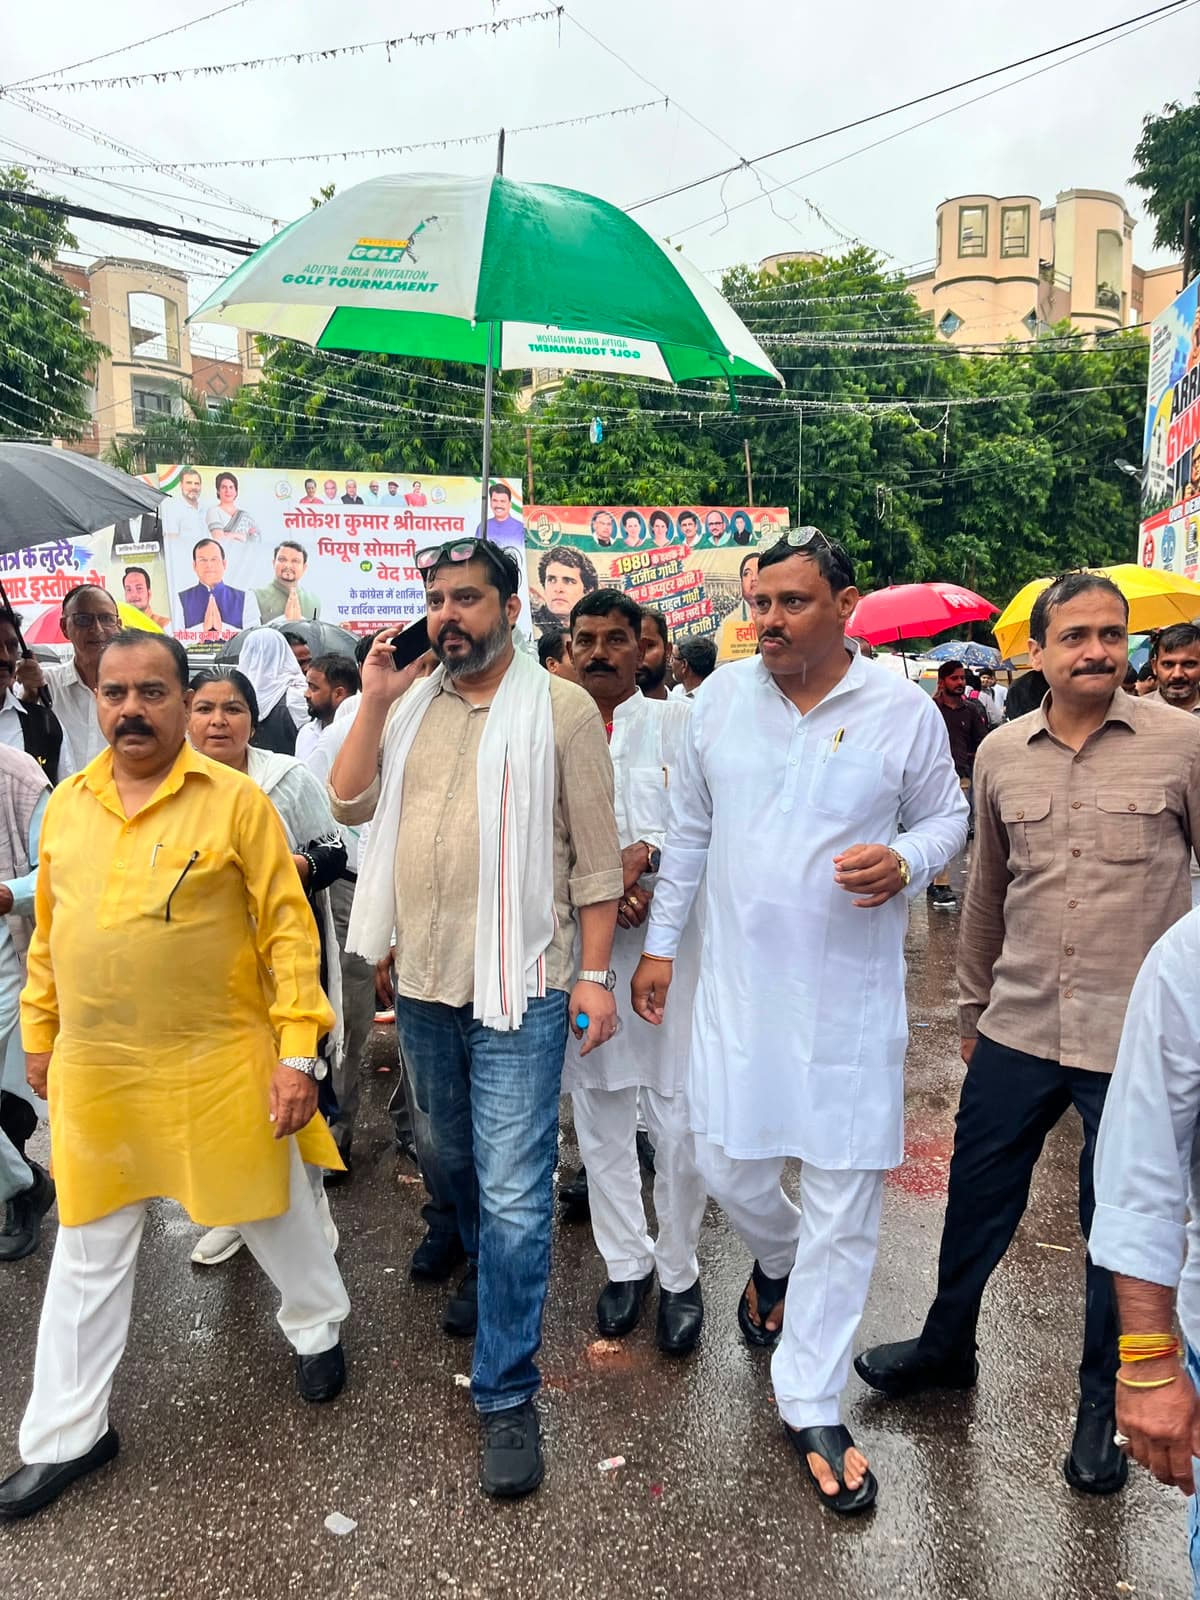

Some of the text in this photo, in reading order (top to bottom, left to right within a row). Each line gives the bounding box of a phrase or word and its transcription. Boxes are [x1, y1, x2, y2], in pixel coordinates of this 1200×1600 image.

[351, 247, 403, 261] GOLF
[303, 264, 429, 280] ADITYA BIRLA INVITATION
[282, 274, 439, 292] GOLF TOURNAMENT
[1170, 363, 1200, 423] ARR
[283, 508, 465, 536] लोकेश कुमार श्रीवास्तव
[317, 537, 417, 562] पियूष सोमानी
[376, 562, 400, 582] वेद
[616, 552, 650, 575] 1980
[658, 560, 678, 576] गांधी
[349, 587, 424, 600] के कांग्रेस में शामिल
[659, 596, 681, 612] राहुल
[681, 588, 700, 604] गांधी
[338, 605, 349, 615] पर
[351, 602, 375, 615] हार्दिक
[377, 605, 402, 615] स्वागत
